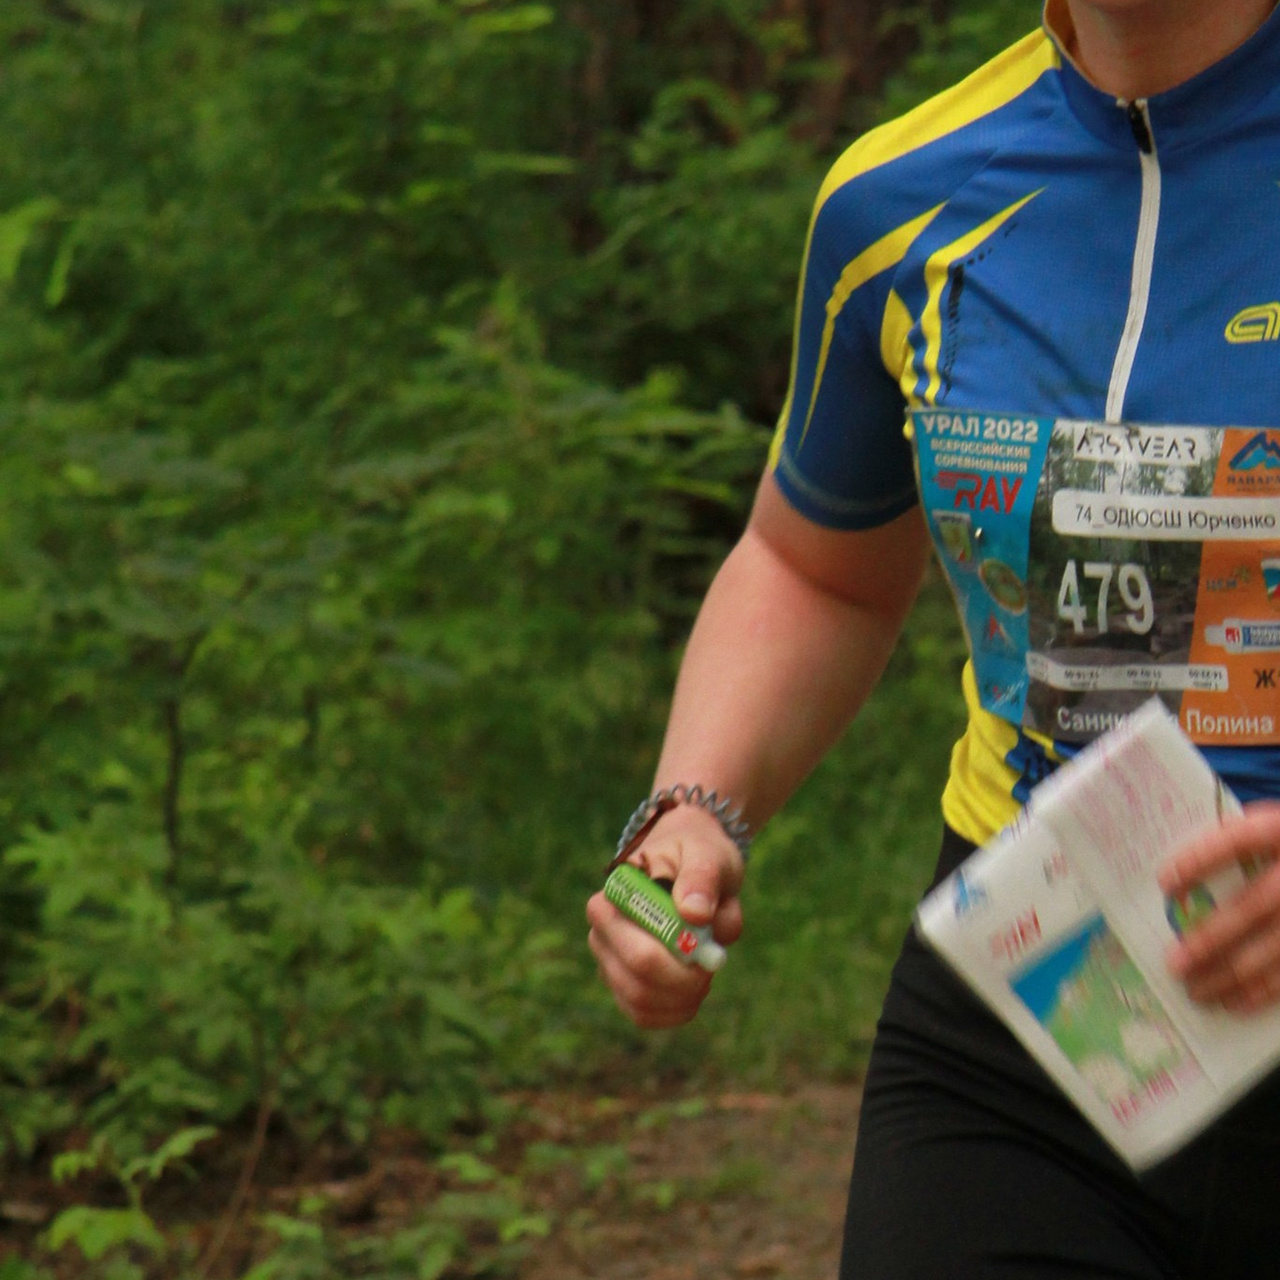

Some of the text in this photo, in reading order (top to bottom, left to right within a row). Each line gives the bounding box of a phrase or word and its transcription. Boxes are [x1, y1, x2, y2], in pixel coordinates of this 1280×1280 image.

[921, 413, 1039, 442] УРАЛ 2022
[930, 437, 1031, 459] ВСЕРОССИЙСКИЕ
[934, 452, 1028, 473] СОРЕВНОВАНИЯ
[1188, 511, 1276, 532] Юрченко
[1057, 559, 1154, 636] 479
[1186, 707, 1274, 734] Полина
